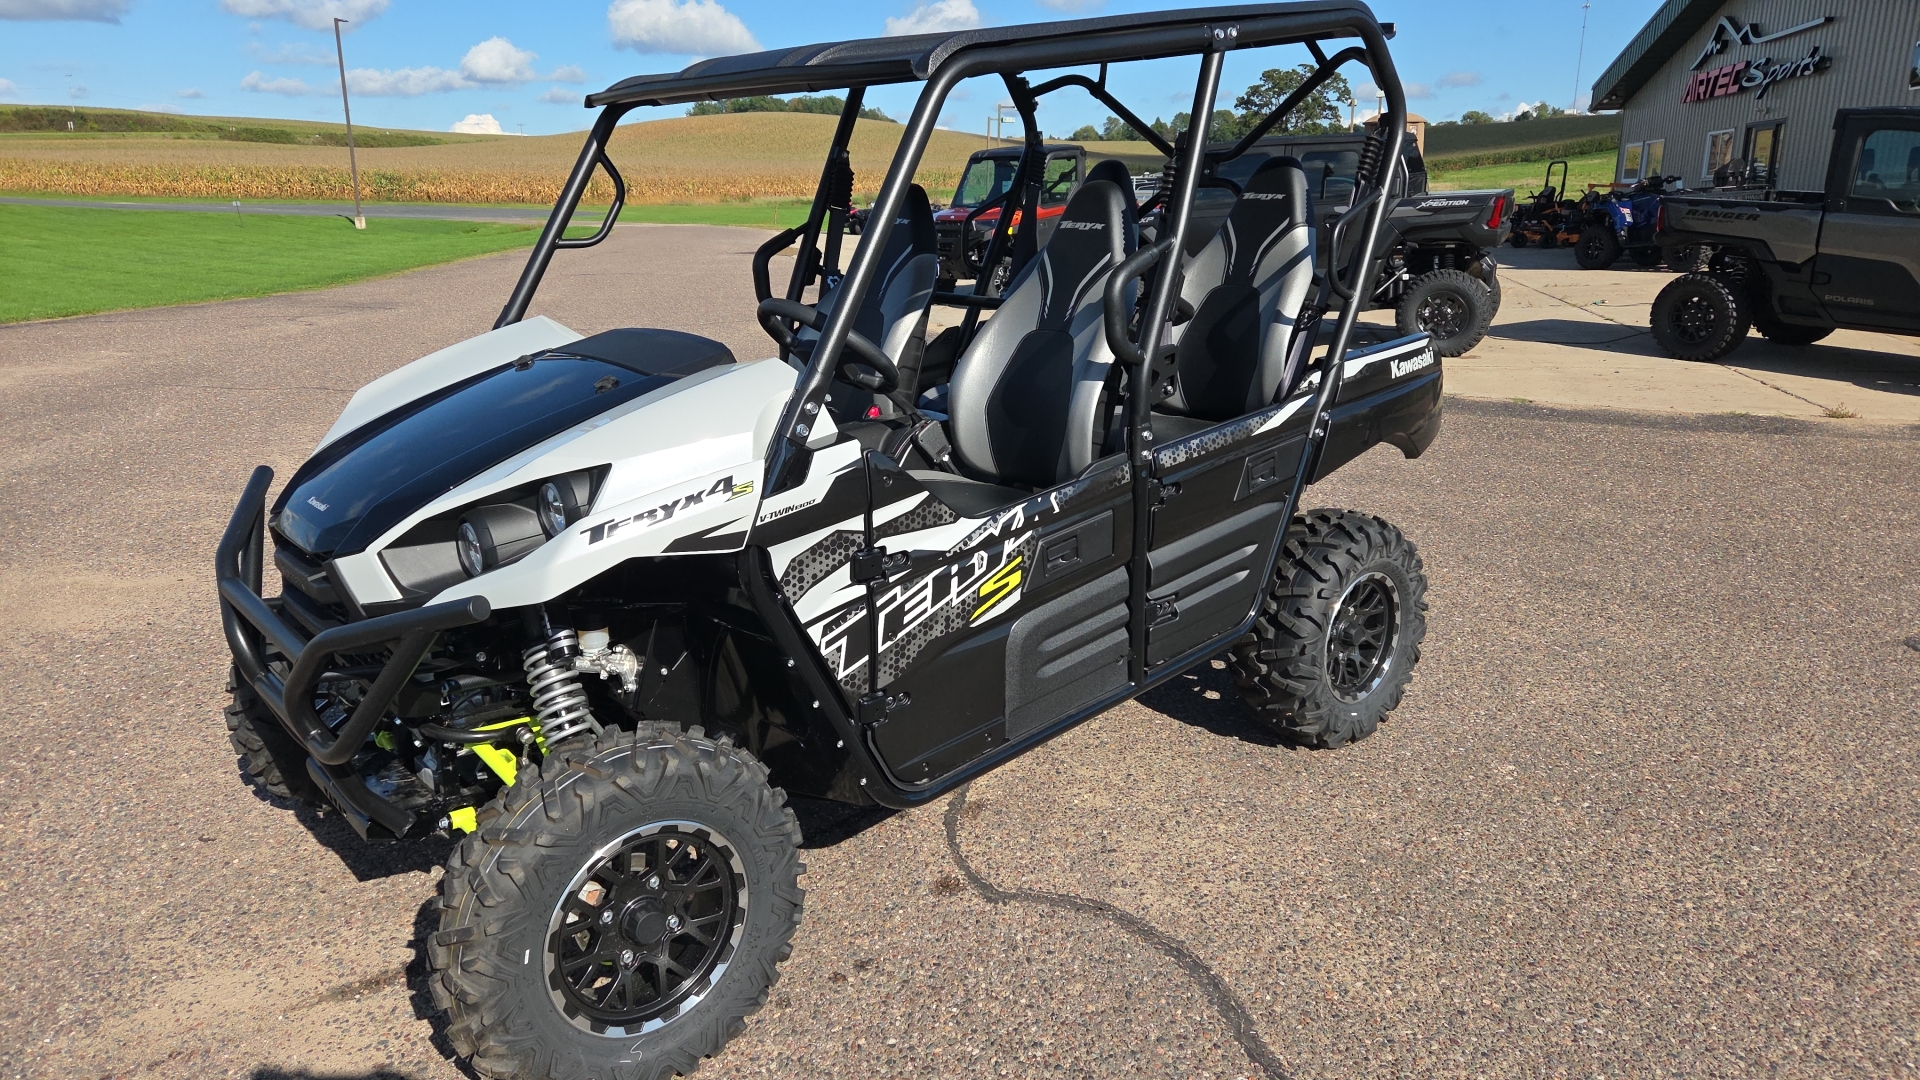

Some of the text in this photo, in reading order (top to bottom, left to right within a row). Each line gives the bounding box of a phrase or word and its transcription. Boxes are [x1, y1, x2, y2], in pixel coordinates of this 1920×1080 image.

[1681, 46, 1820, 103] AIRTEC Sports
[1416, 199, 1470, 209] XPEDITION
[1685, 209, 1761, 222] RANGER
[1824, 294, 1875, 306] POLARIS
[1390, 346, 1434, 379] Kawasaki
